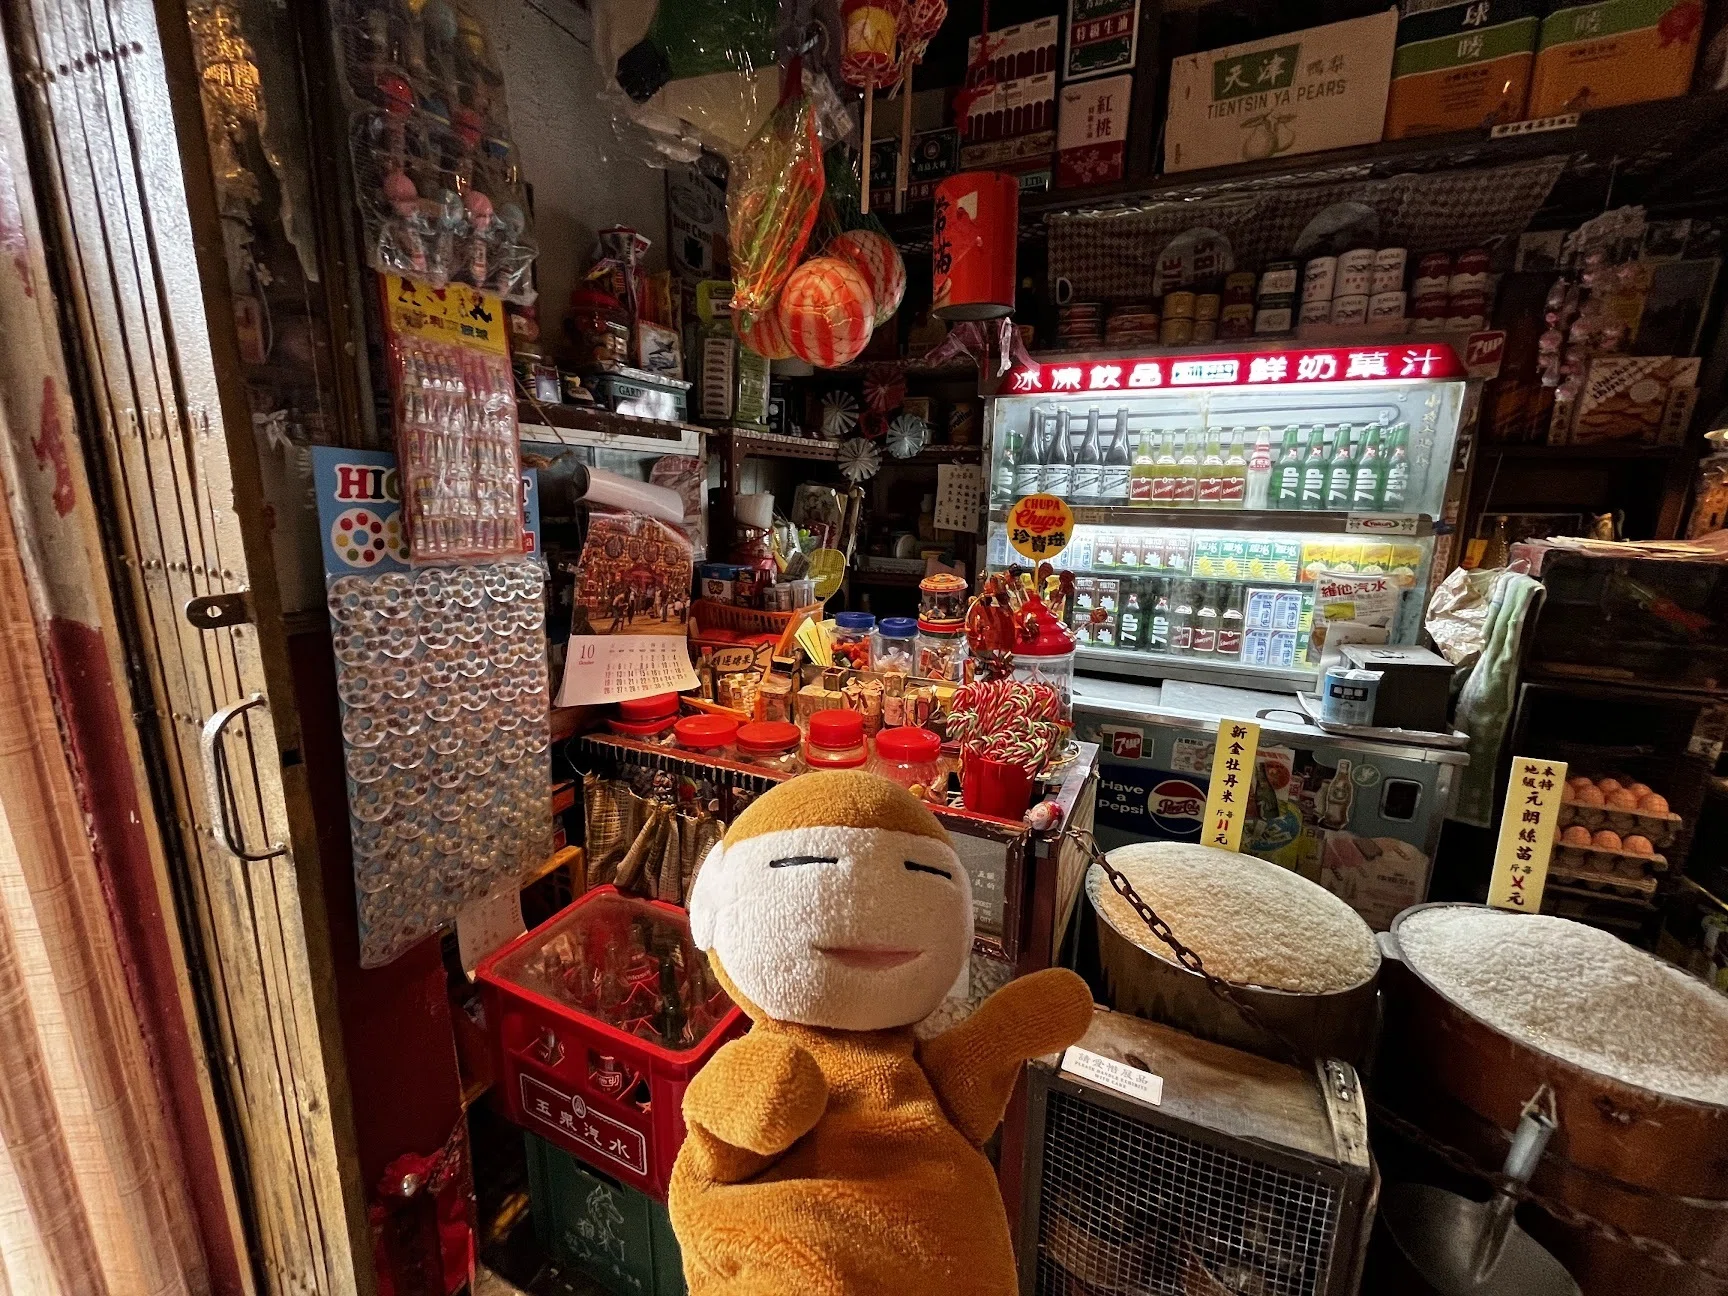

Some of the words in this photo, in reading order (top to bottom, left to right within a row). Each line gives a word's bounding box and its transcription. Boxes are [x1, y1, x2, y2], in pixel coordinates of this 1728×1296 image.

[1222, 53, 1286, 94] 天津
[1207, 93, 1268, 119] TIENTSIN
[1274, 89, 1290, 105] YA
[1297, 80, 1346, 102] PEARS
[1096, 94, 1113, 138] 紅桃
[1247, 349, 1441, 383] 鮮奶菓汁
[1280, 467, 1300, 499] 7UP
[1303, 468, 1324, 501] 7UP
[1328, 468, 1350, 501] 7UP
[1354, 468, 1378, 501] 7UP
[1024, 498, 1061, 510] CHUPA
[1015, 509, 1066, 533] Chups
[1368, 519, 1395, 528] Yakult
[1012, 528, 1066, 553] 珍寶珠
[1321, 580, 1387, 598] 維他汽水
[1121, 614, 1138, 641] 7UP
[1151, 616, 1169, 644] 7UP
[581, 644, 595, 659] 10
[1222, 725, 1247, 803] 新金牡丹米
[1101, 780, 1144, 794] Have
[1116, 793, 1126, 802] a
[1099, 800, 1144, 815] Pepsi
[1516, 791, 1543, 861] 元朗絲苗
[1074, 1061, 1095, 1072] PLEASE
[1096, 1069, 1119, 1080] HANDLE
[1120, 1077, 1147, 1091] EXHIBITS
[1079, 1052, 1148, 1085] 請愛惜展品
[1094, 1073, 1110, 1082] WITH
[1111, 1079, 1126, 1089] CARE
[535, 1098, 631, 1159] 玉泉汽水
